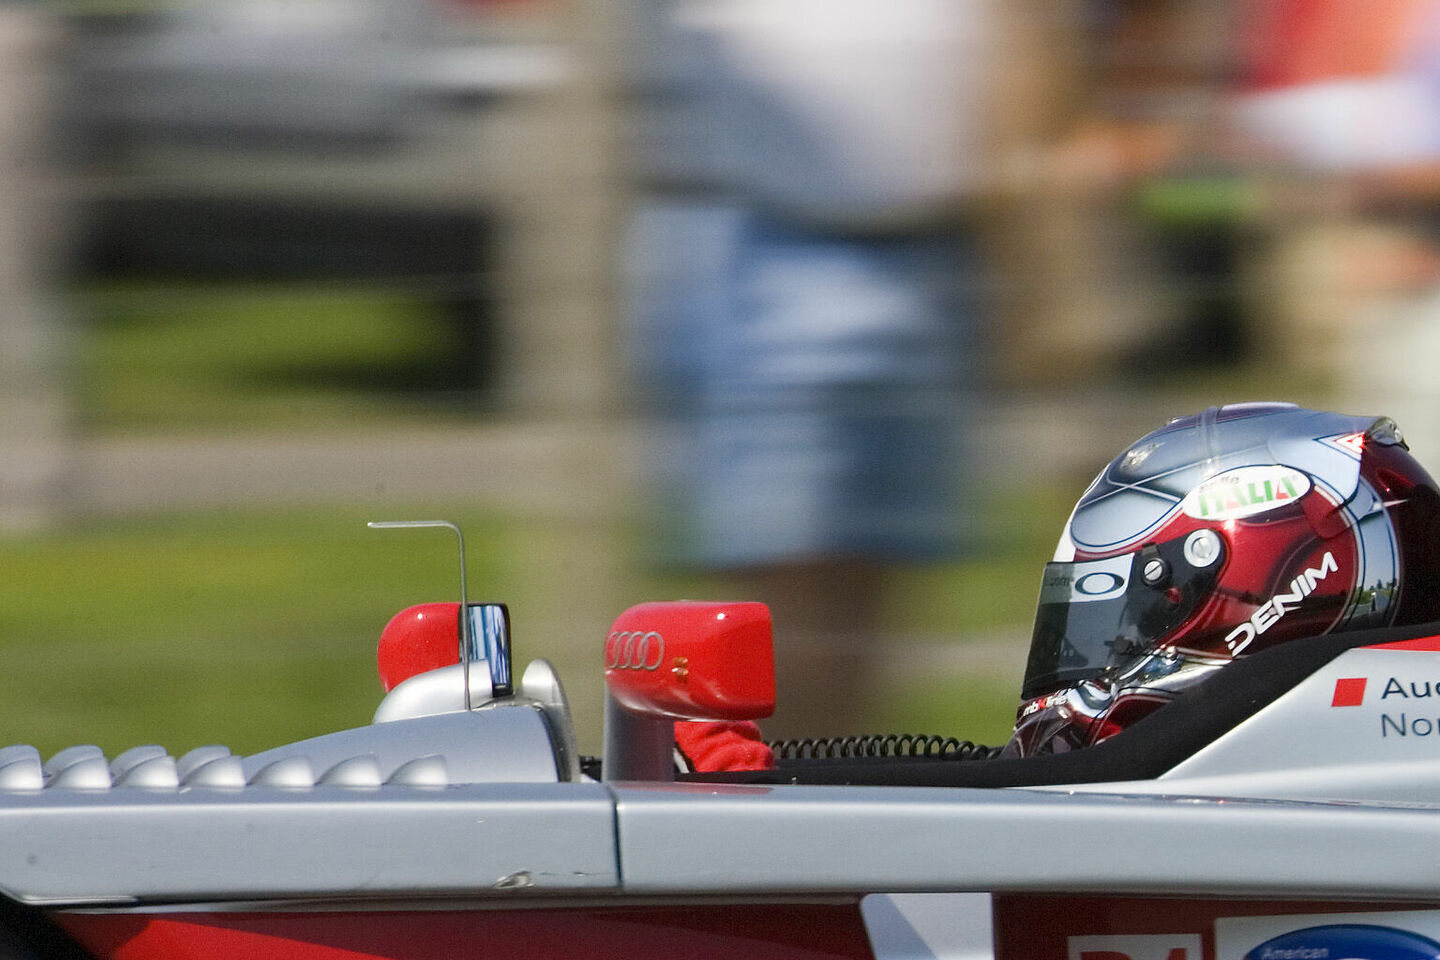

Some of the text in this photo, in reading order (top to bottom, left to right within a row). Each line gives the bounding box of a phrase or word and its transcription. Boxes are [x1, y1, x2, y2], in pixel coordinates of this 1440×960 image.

[1198, 476, 1298, 517] ITALIA
[1223, 550, 1340, 658] DENIM
[1261, 945, 1329, 960] American
